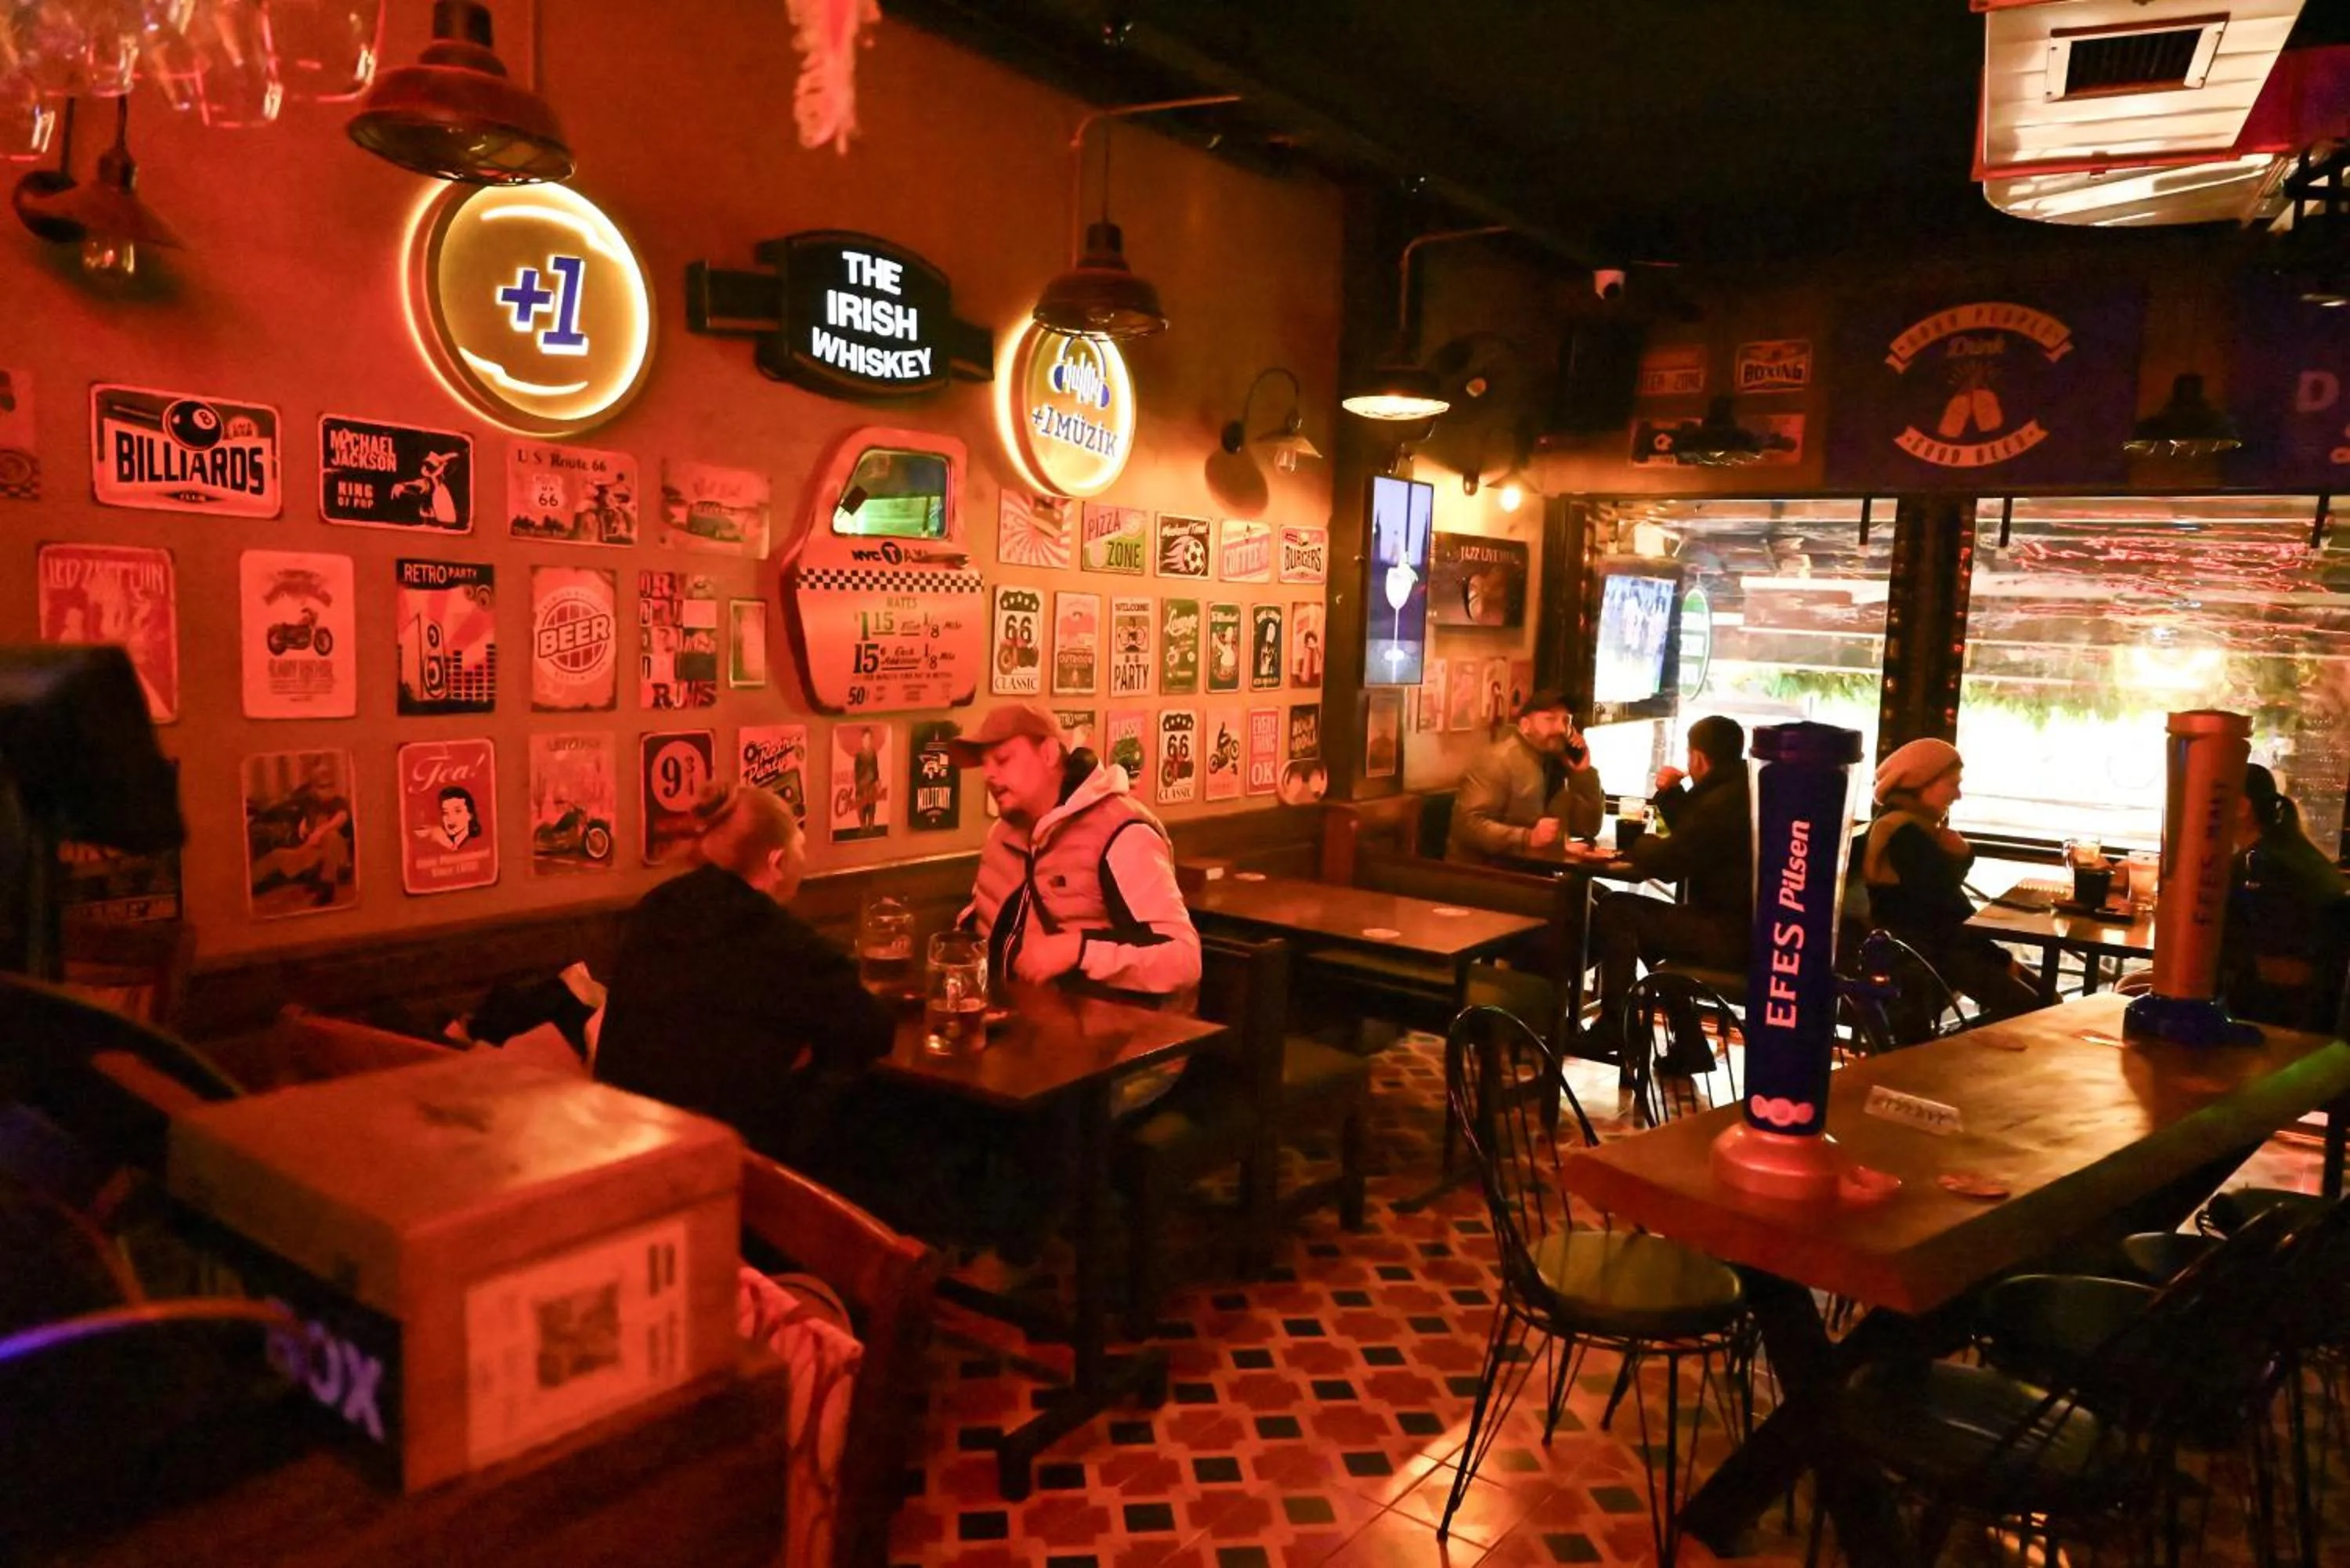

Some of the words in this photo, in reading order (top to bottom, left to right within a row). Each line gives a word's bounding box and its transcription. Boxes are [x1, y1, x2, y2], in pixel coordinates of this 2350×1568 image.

[842, 251, 903, 295] THE
[497, 255, 588, 355] +1
[827, 289, 918, 341] IRISH
[812, 326, 932, 378] WHISKEY
[1744, 363, 1803, 381] BOXING
[330, 428, 395, 454] MICHAEL
[116, 430, 265, 496] BILLIARDS
[331, 448, 397, 473] JACKSON
[538, 492, 559, 507] 66
[1088, 510, 1122, 541] PIZZA
[1108, 540, 1141, 569] ZONE
[1285, 545, 1322, 573] BURGERS
[404, 563, 447, 584] RETRO
[448, 566, 477, 580] PARTY
[537, 613, 610, 659] BEER
[1005, 614, 1032, 645] 66
[995, 676, 1038, 691] CLASSIC
[1114, 663, 1149, 692] PARTY
[1167, 734, 1189, 759] 66
[408, 753, 486, 794] Tea!
[1251, 761, 1275, 786] OK
[917, 786, 951, 814] MILITARY
[1159, 787, 1191, 801] CLASSIC
[1778, 819, 1810, 912] Pilsen
[1765, 922, 1805, 1028] EFES
